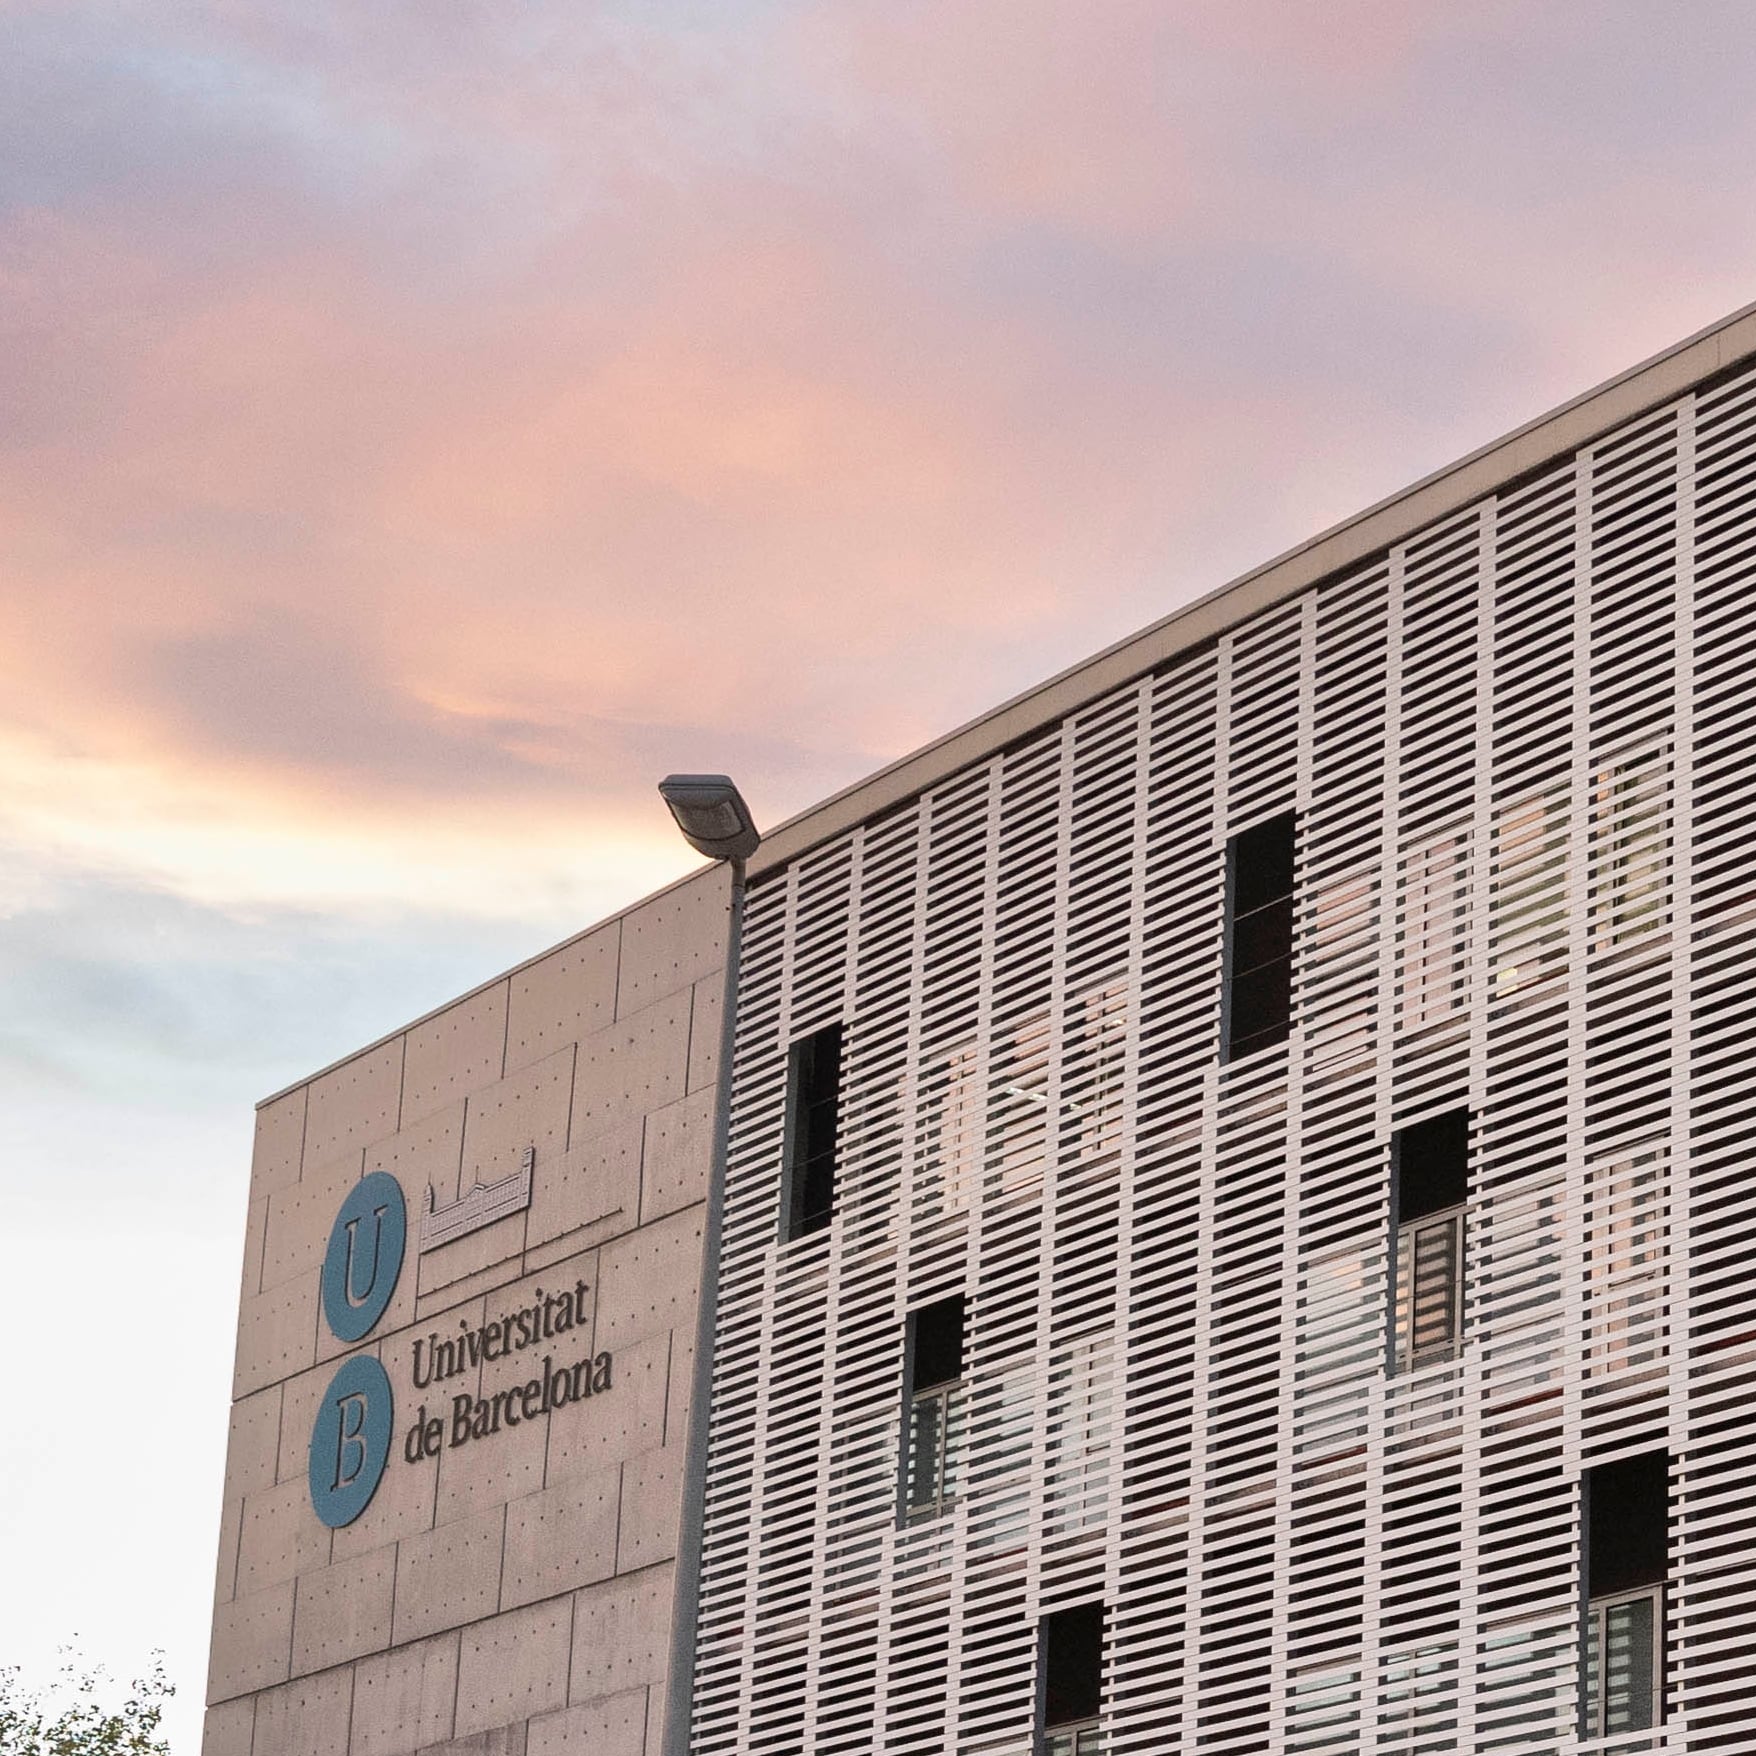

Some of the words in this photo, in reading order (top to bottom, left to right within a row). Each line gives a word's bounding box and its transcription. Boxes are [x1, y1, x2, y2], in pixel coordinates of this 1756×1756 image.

[344, 1204, 389, 1308] U
[411, 1280, 589, 1390] Universitat
[330, 1392, 369, 1493] B
[404, 1406, 445, 1464] de
[448, 1351, 613, 1449] Barcelona
